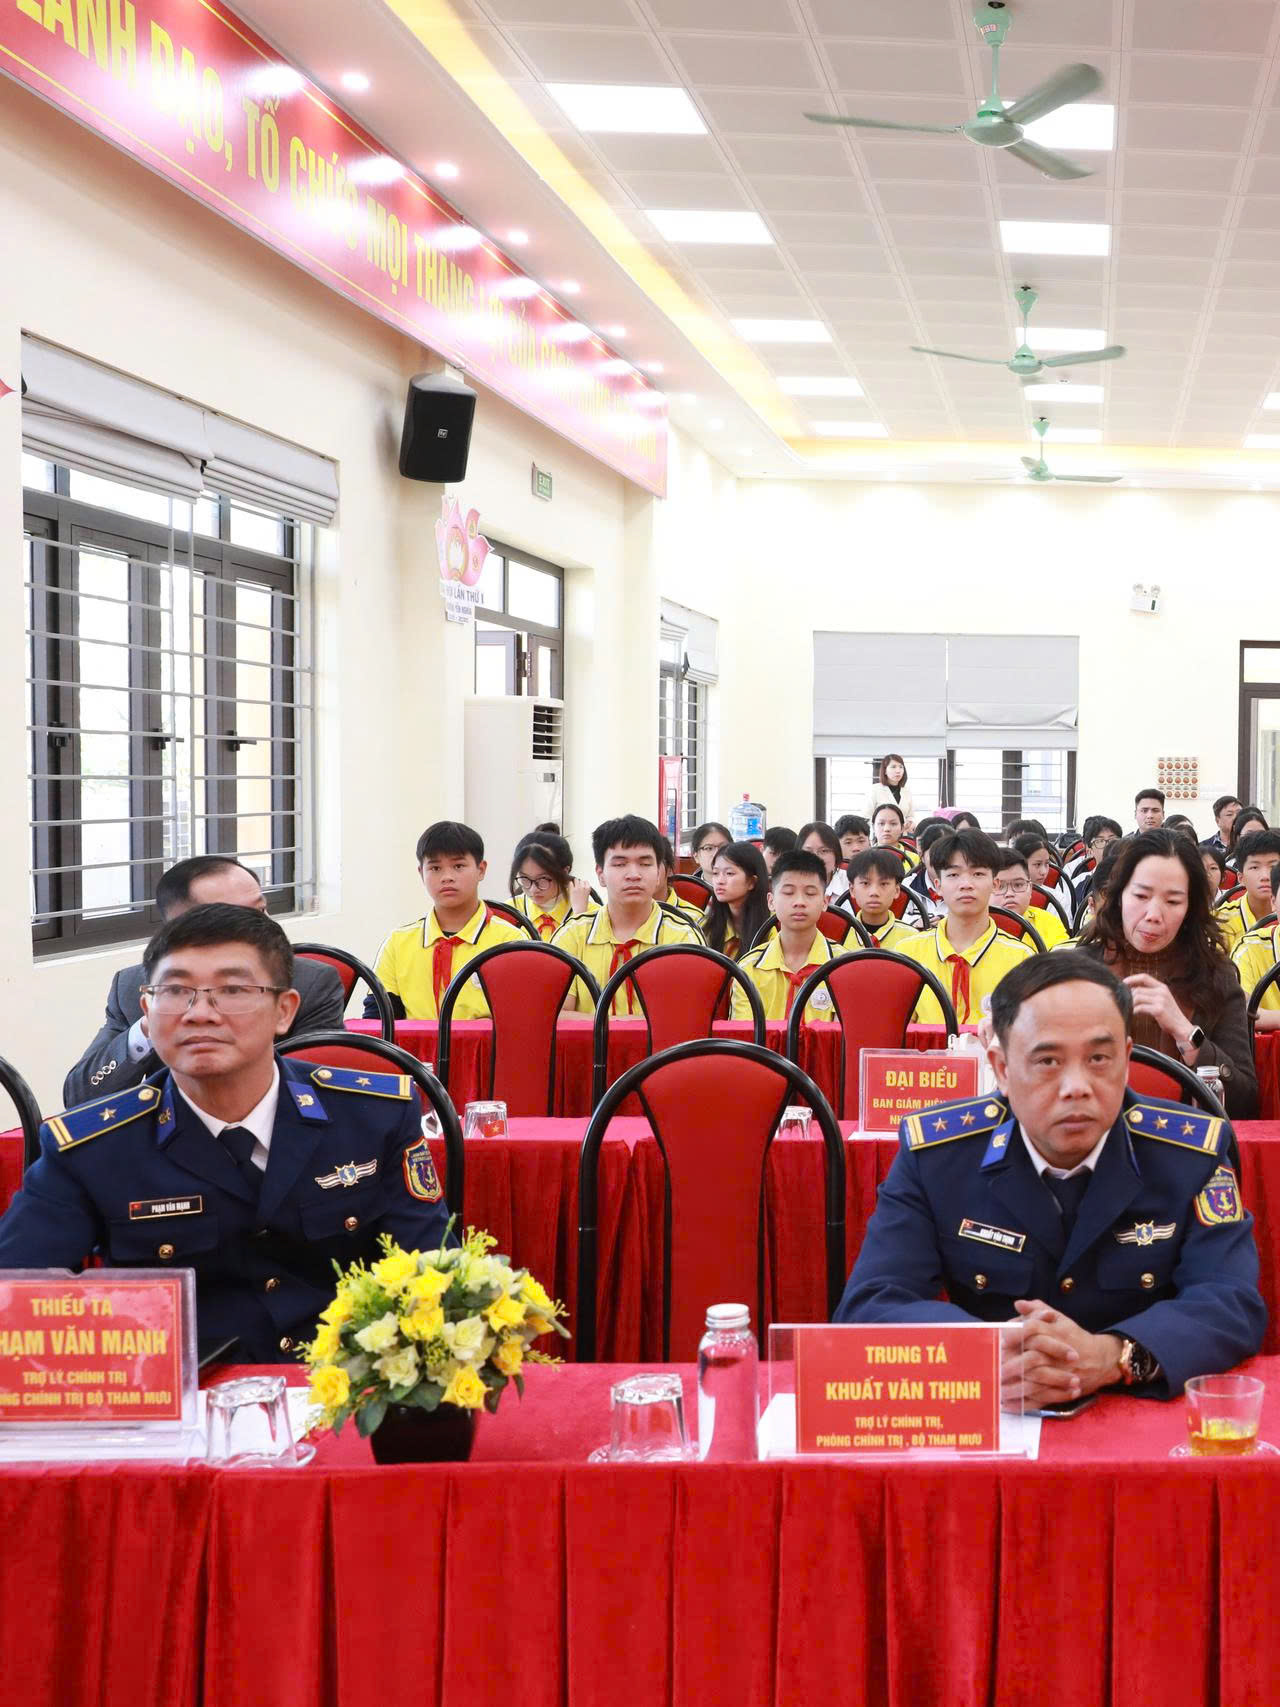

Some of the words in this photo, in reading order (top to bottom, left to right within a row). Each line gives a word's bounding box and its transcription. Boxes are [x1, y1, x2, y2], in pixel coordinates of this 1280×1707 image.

[886, 1070, 914, 1090] ĐẠI
[919, 1066, 958, 1088] BIỂU
[873, 1098, 893, 1109] BAN
[896, 1097, 921, 1109] GIÁM
[31, 1293, 85, 1317] THIẾU
[0, 1330, 45, 1361] HẠM
[51, 1325, 95, 1356] VĂN
[102, 1330, 167, 1361] MẠNH
[865, 1346, 922, 1364] TRUNG
[926, 1342, 948, 1364] TÁ
[106, 1392, 141, 1405] THAM
[826, 1375, 883, 1401] KHUẤT
[888, 1378, 924, 1400] VĂN
[929, 1381, 982, 1403] THỊNH
[855, 1415, 874, 1430] TRỢ
[877, 1414, 888, 1428] LÝ
[891, 1414, 923, 1429] CHÍNH
[816, 1432, 851, 1447] PHÒNG
[854, 1432, 885, 1447] CHÍNH
[912, 1432, 925, 1448] BỘ
[928, 1433, 957, 1446] THAM
